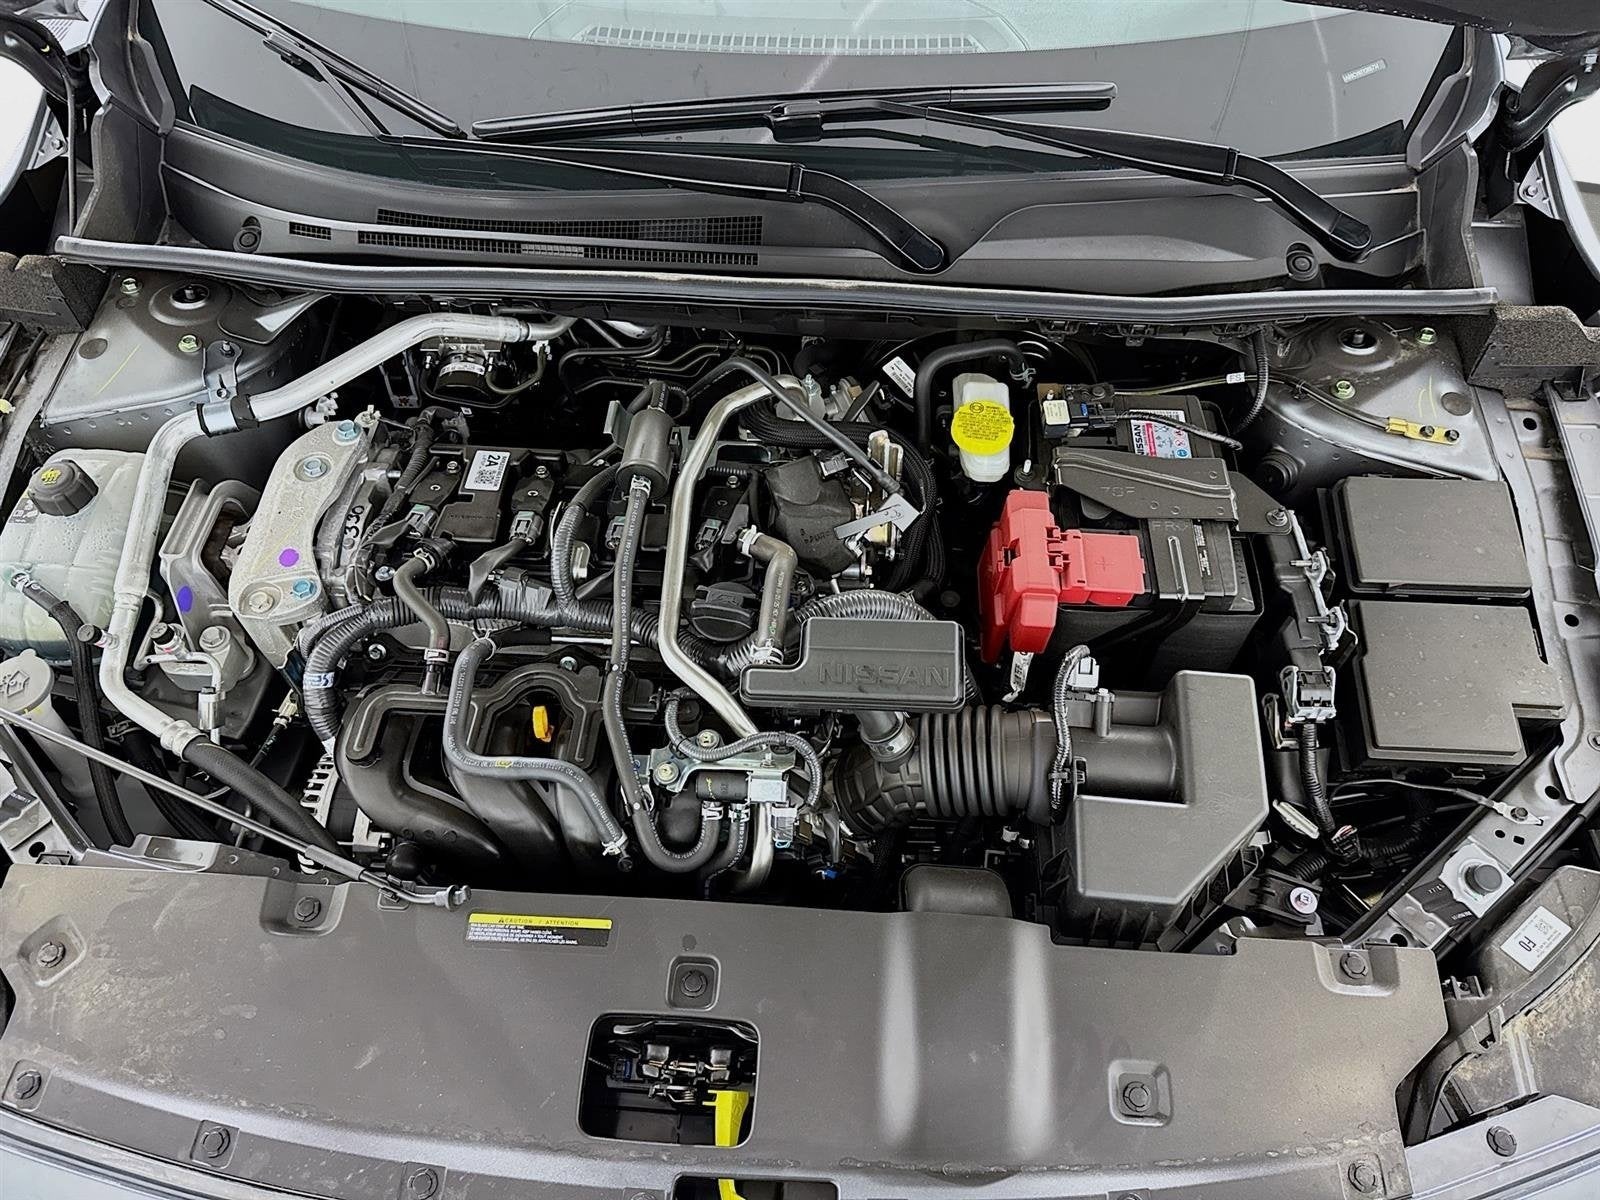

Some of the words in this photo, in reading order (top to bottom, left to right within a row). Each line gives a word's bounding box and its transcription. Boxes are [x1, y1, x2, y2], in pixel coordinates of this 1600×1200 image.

[485, 454, 501, 467] 2A
[343, 504, 366, 538] 330
[818, 662, 951, 689] NISSAN
